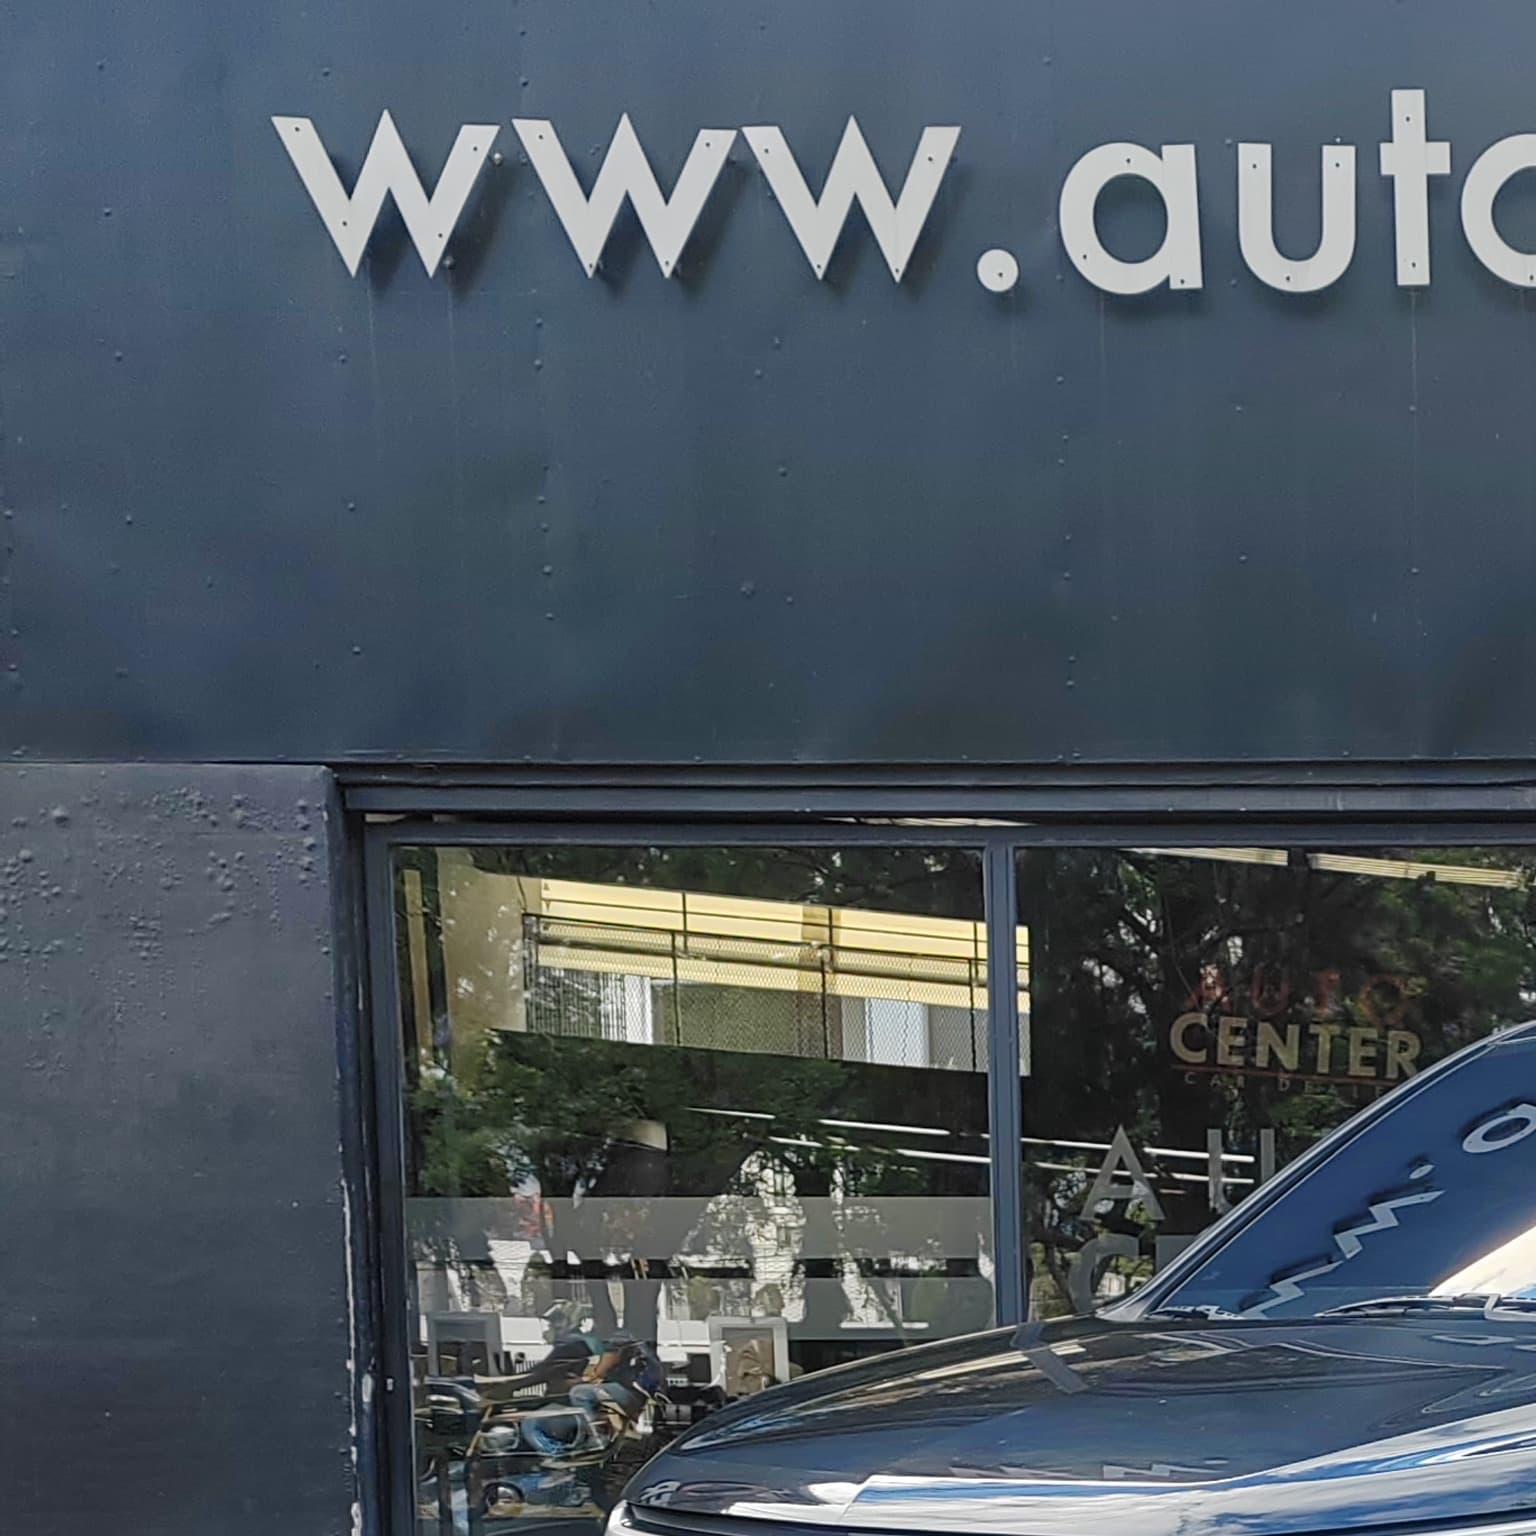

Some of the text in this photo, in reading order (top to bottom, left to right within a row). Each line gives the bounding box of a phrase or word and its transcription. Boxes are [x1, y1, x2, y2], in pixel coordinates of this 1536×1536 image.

[1170, 1011, 1421, 1079] CENTER
[1184, 1072, 1385, 1098] CAR DEALE
